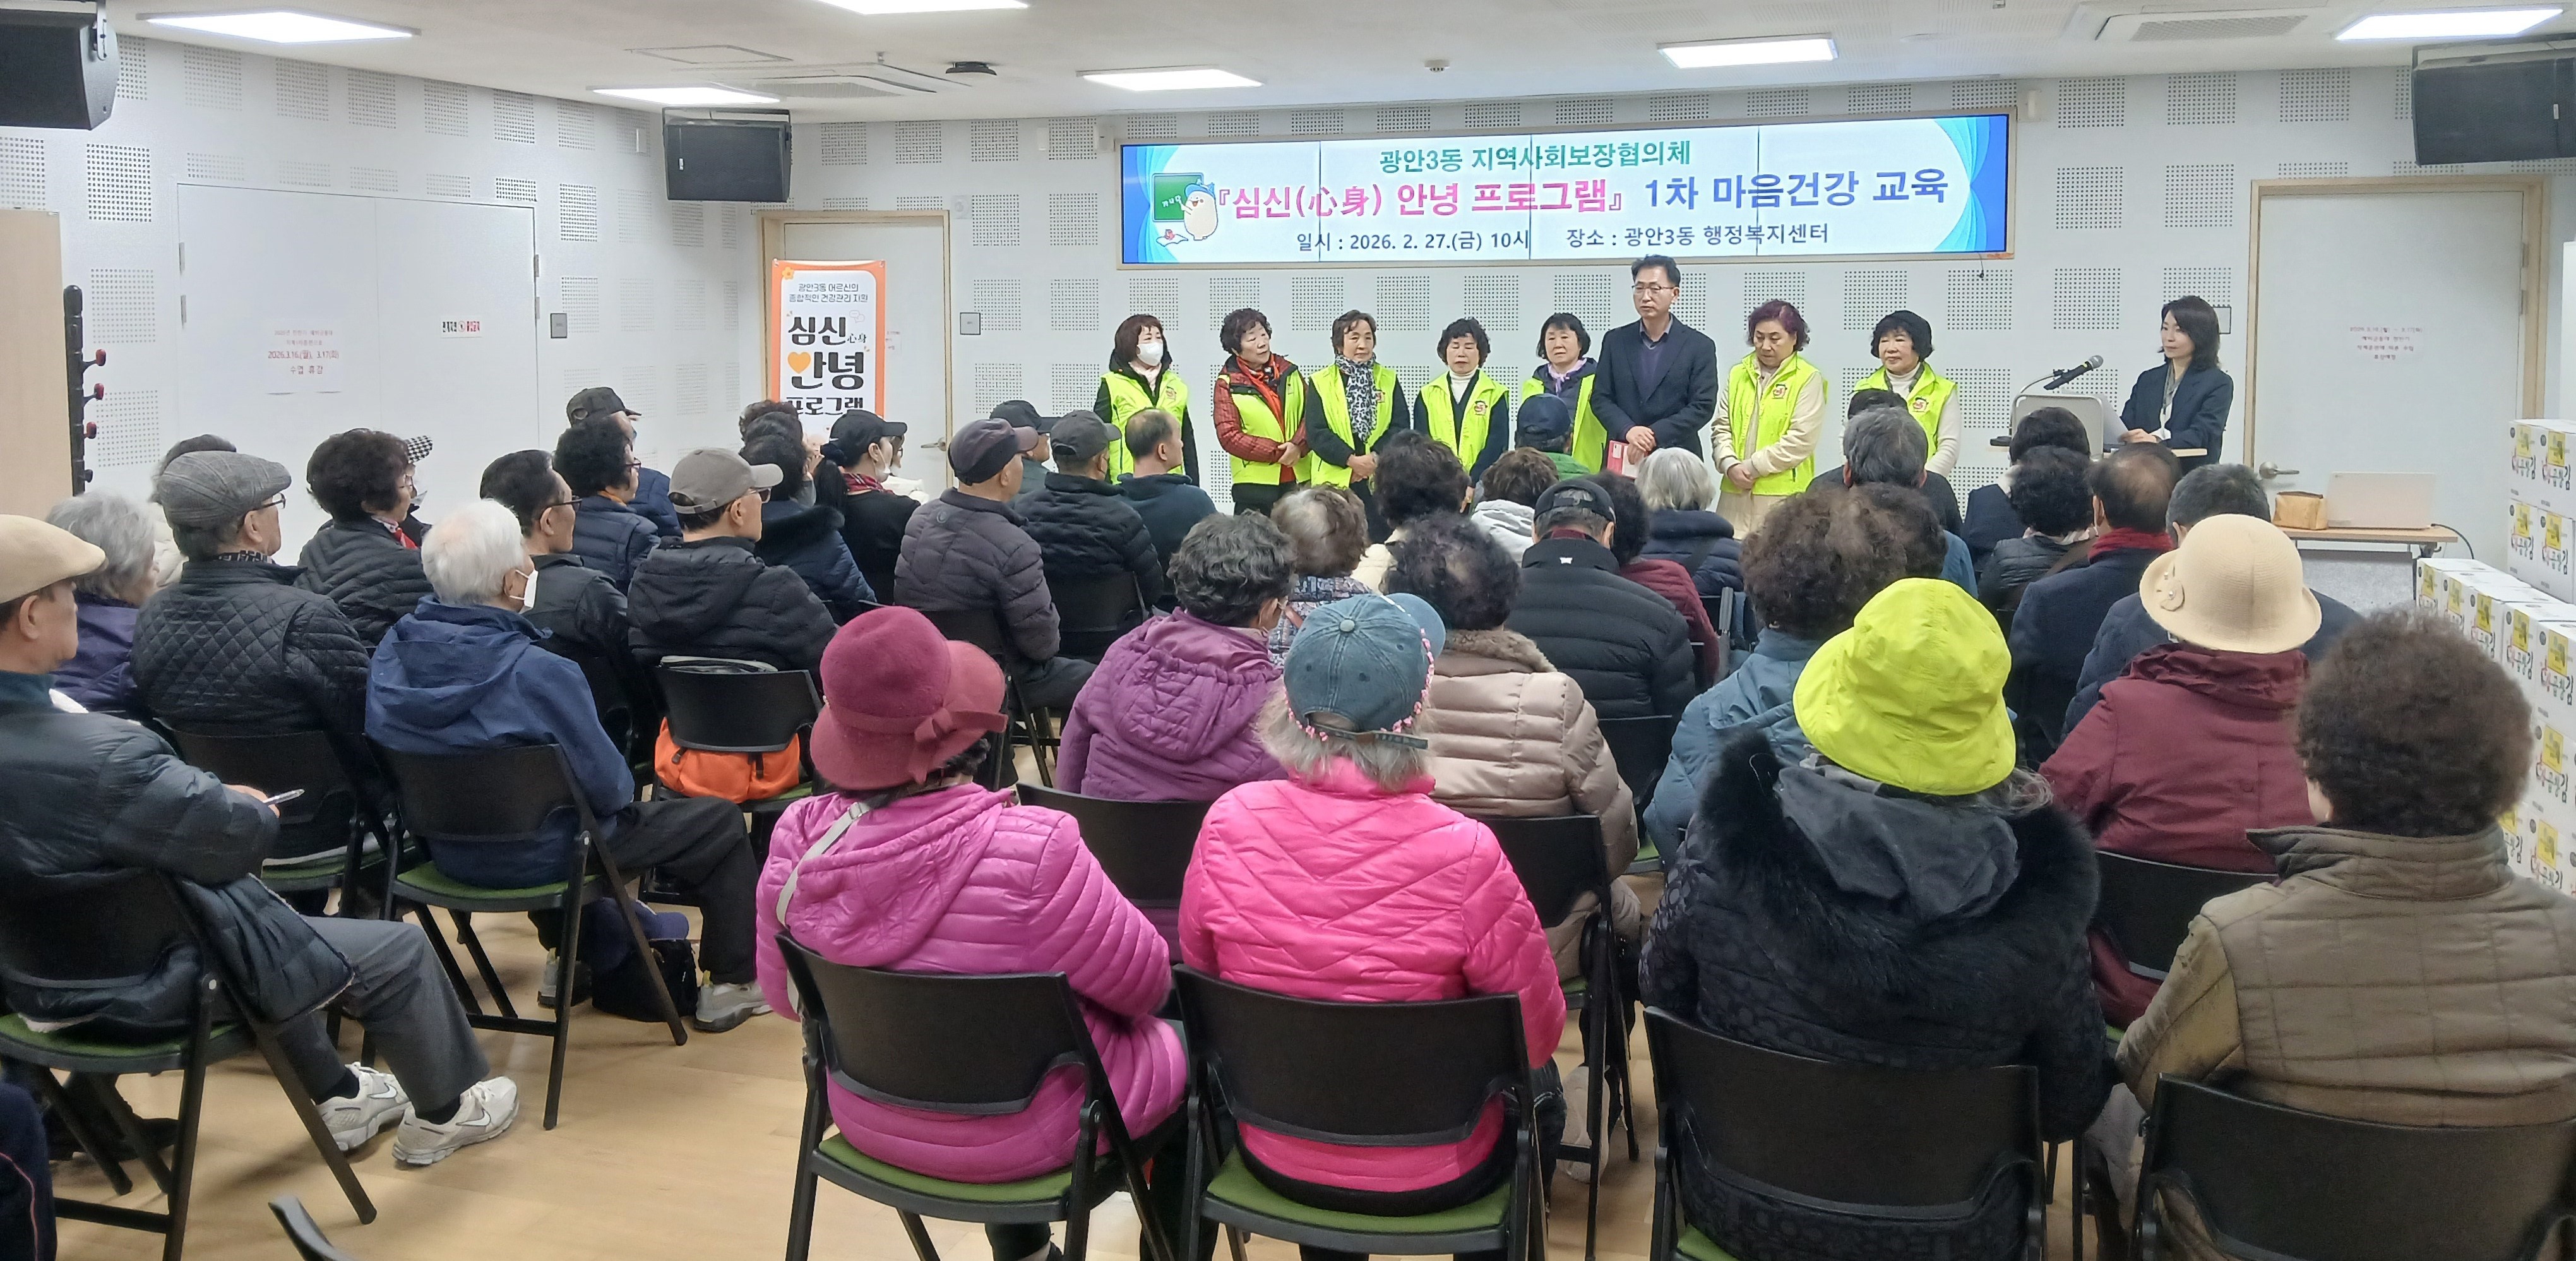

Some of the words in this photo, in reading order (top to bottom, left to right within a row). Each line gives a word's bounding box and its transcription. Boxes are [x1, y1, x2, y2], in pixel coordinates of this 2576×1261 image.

[1380, 148, 1464, 174] 광안3동
[1471, 140, 1691, 171] 지역사회보장협의체
[1397, 182, 1459, 216] 안녕
[1645, 176, 1700, 210] 1차
[1713, 170, 1859, 208] 마음건강
[1872, 168, 1949, 203] 교육
[1296, 232, 1331, 252] 일시
[1349, 234, 1396, 251] 2026.
[1402, 234, 1418, 249] 2.
[1424, 230, 1483, 252] 27.(금)
[1491, 229, 1530, 250] 10시
[1566, 228, 1605, 248] 장소
[1624, 225, 1696, 247] 광안3동
[1703, 222, 1828, 246] 행정복지센터
[789, 294, 820, 303] 종합적인
[821, 294, 852, 303] 건강관리
[852, 294, 869, 303] 지원
[798, 283, 826, 292] 광안3동
[828, 283, 859, 292] 어르신의
[787, 316, 847, 346] 심신
[787, 351, 864, 390] 안녕
